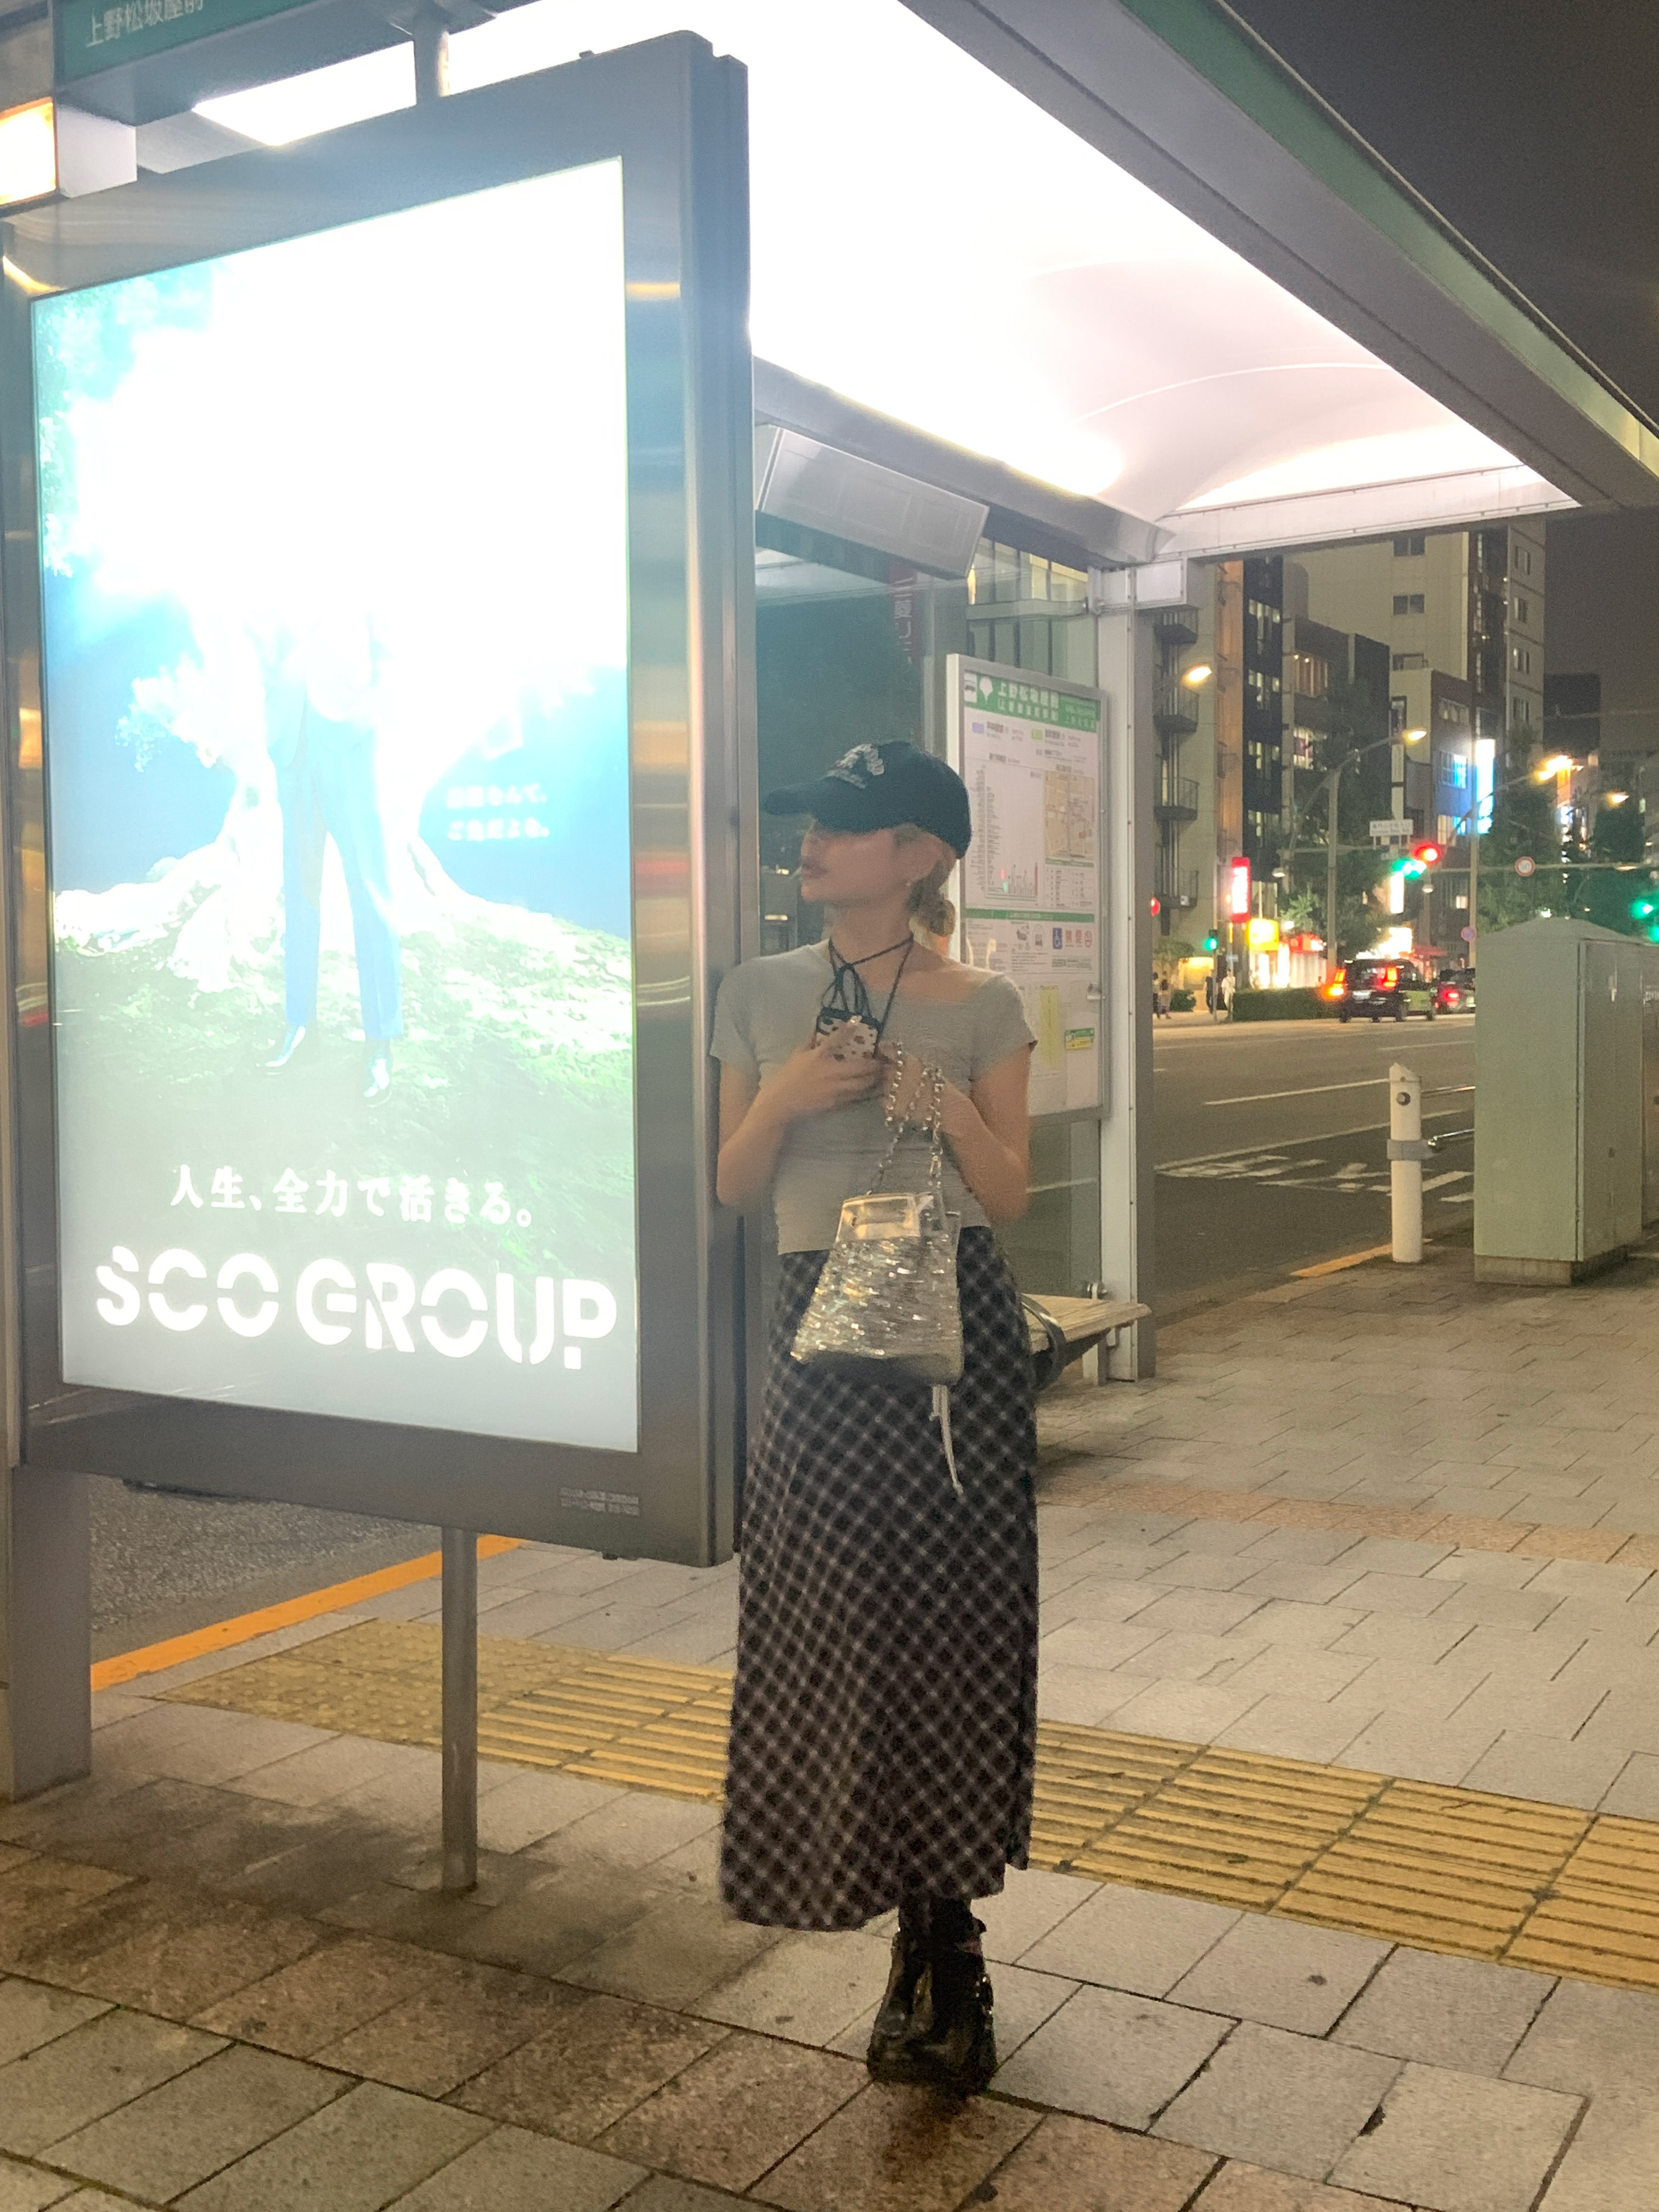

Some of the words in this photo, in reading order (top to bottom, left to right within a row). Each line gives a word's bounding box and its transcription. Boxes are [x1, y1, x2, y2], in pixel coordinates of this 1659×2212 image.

[170, 1164, 533, 1228] 人生、全力で活きる。
[95, 1245, 280, 1338] SCO
[295, 1258, 617, 1370] GROUP
